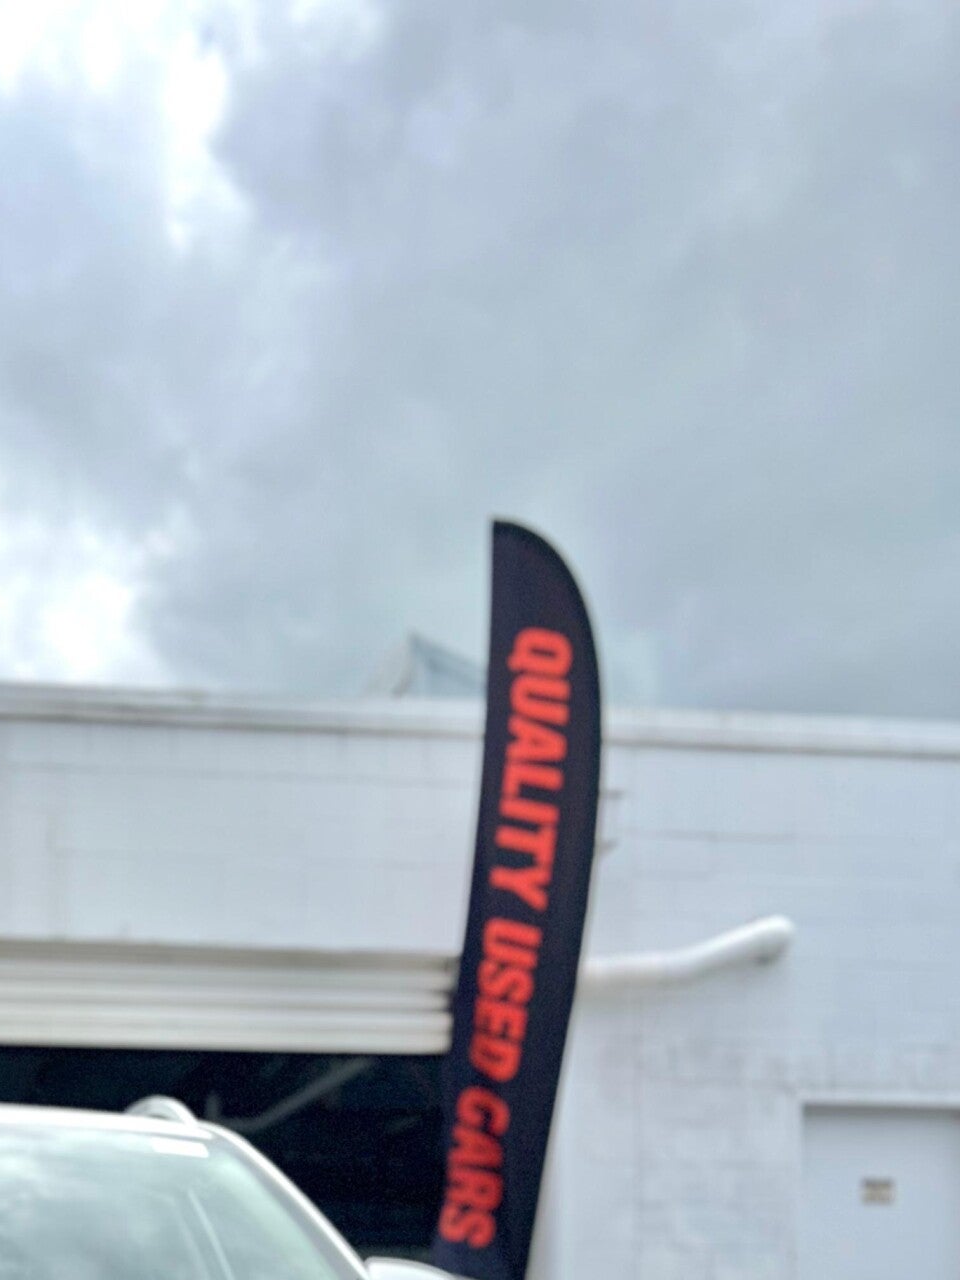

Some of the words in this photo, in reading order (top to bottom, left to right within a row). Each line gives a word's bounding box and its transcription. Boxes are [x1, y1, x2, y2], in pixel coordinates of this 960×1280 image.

[489, 627, 573, 910] QUALITY
[471, 917, 542, 1081] USED
[439, 1087, 509, 1248] CARS
